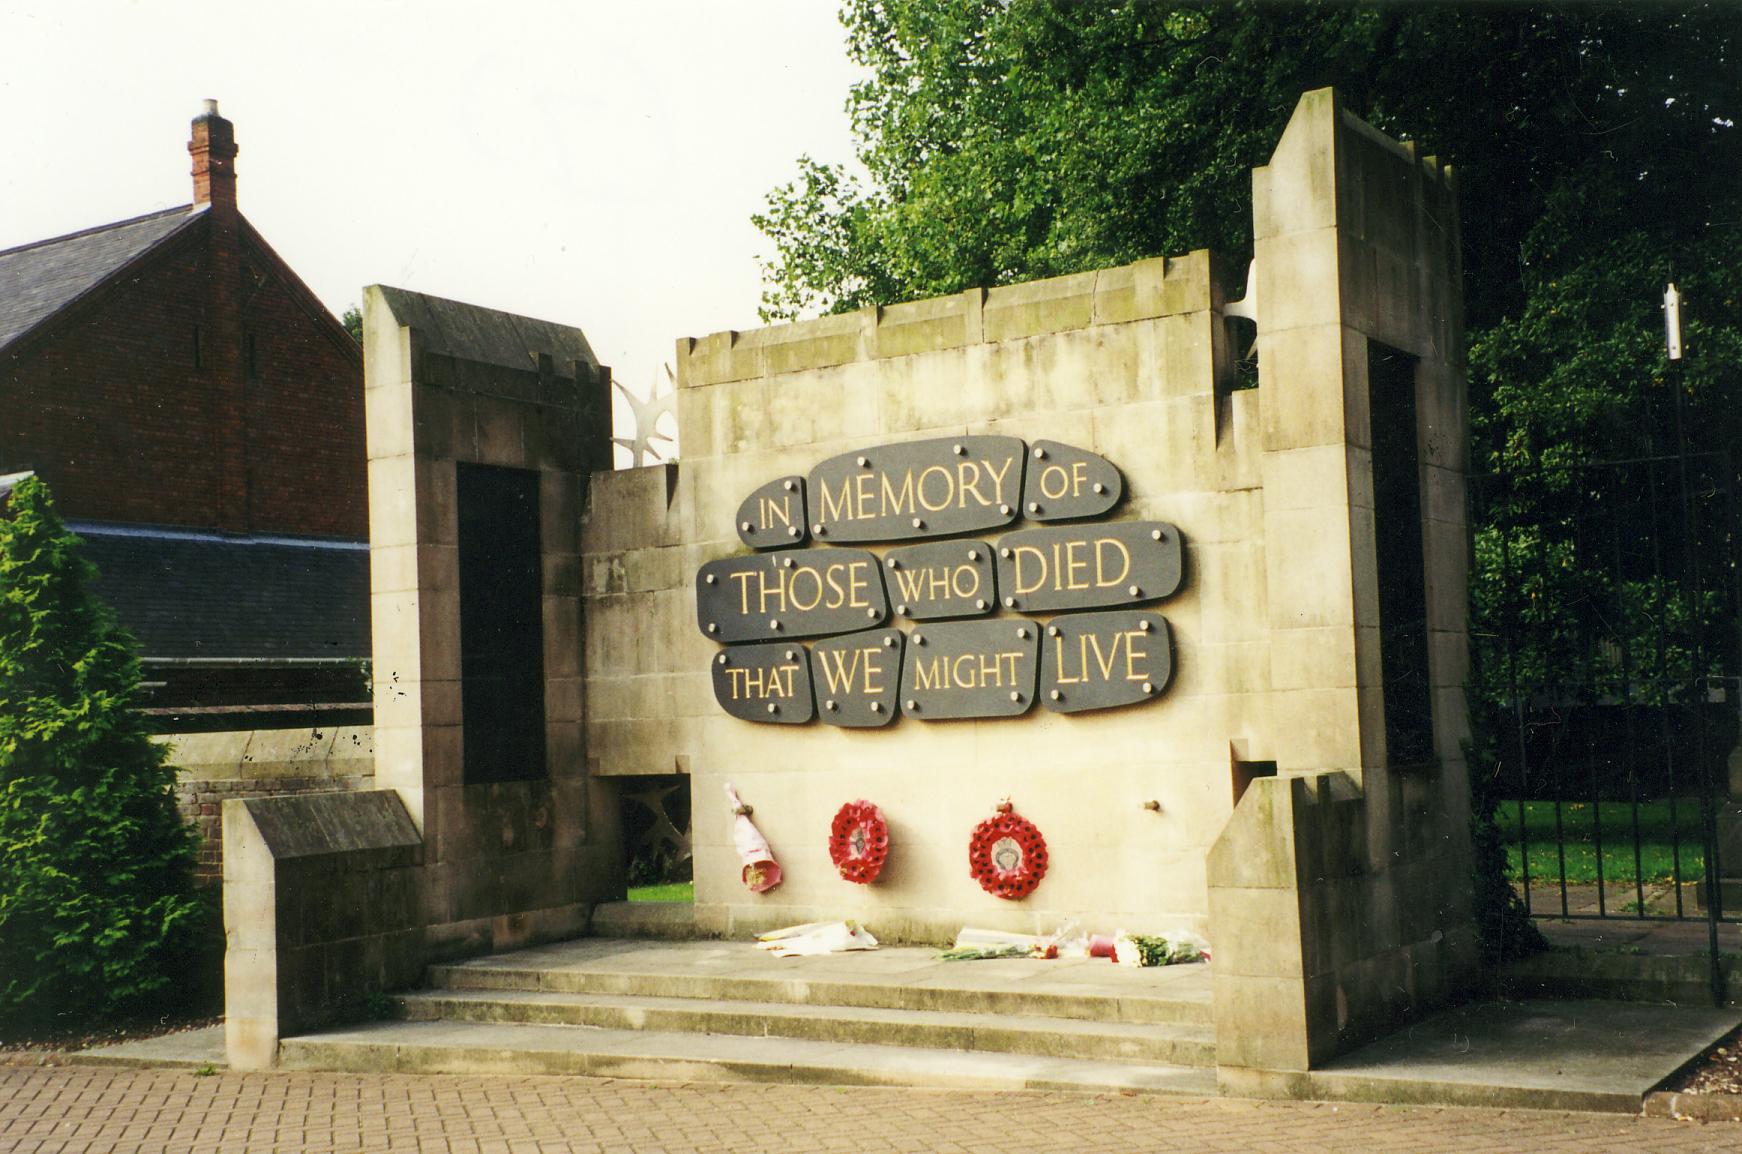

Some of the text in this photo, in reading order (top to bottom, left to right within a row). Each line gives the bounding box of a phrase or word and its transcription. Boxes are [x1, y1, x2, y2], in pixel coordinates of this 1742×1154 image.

[759, 457, 1087, 530] IN MEMORY OF
[730, 538, 1130, 614] THOSE WHO DIED
[725, 631, 1149, 699] THAT WE MIGHT LIVE
